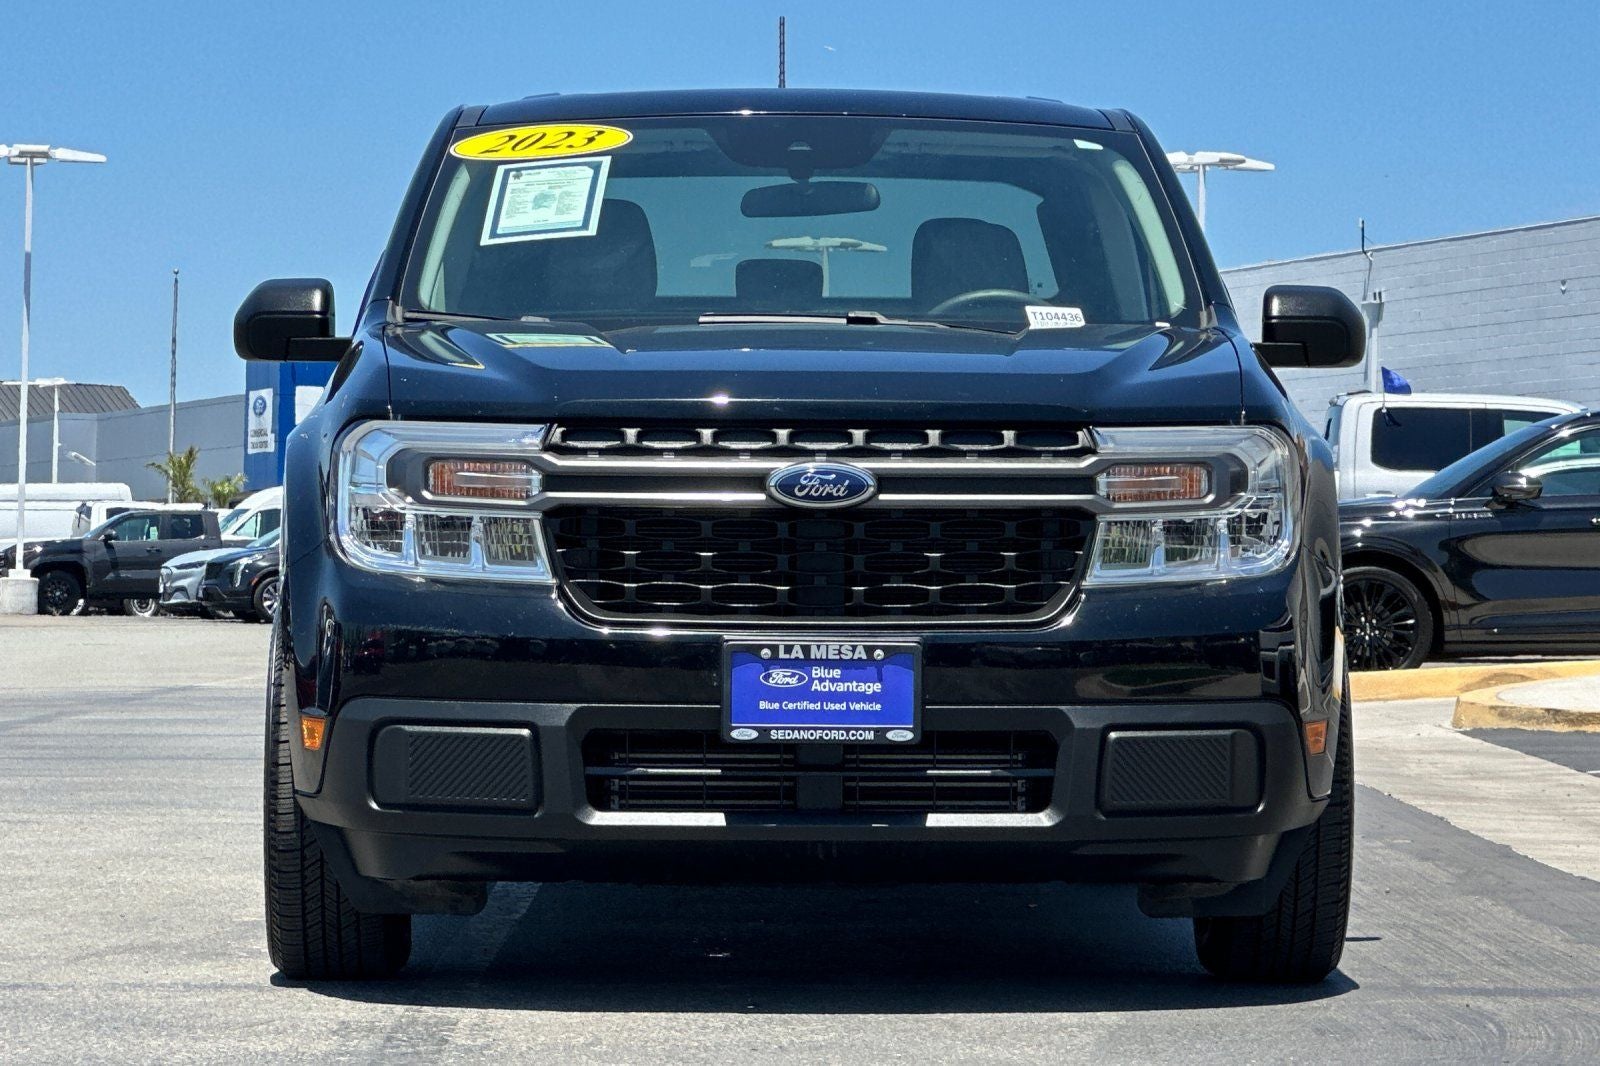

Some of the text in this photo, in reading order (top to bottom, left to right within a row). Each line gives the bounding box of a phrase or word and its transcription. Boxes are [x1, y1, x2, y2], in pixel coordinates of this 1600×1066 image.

[478, 130, 606, 154] 2023
[1031, 311, 1082, 322] T104436
[794, 472, 849, 496] Ford
[778, 644, 868, 660] LA MESA
[769, 671, 800, 685] Ford
[811, 666, 842, 679] Blue
[811, 681, 882, 695] Advantage
[759, 700, 882, 711] Blue Certified Used Vehicle
[770, 729, 875, 740] SEDANOFORD.COM
